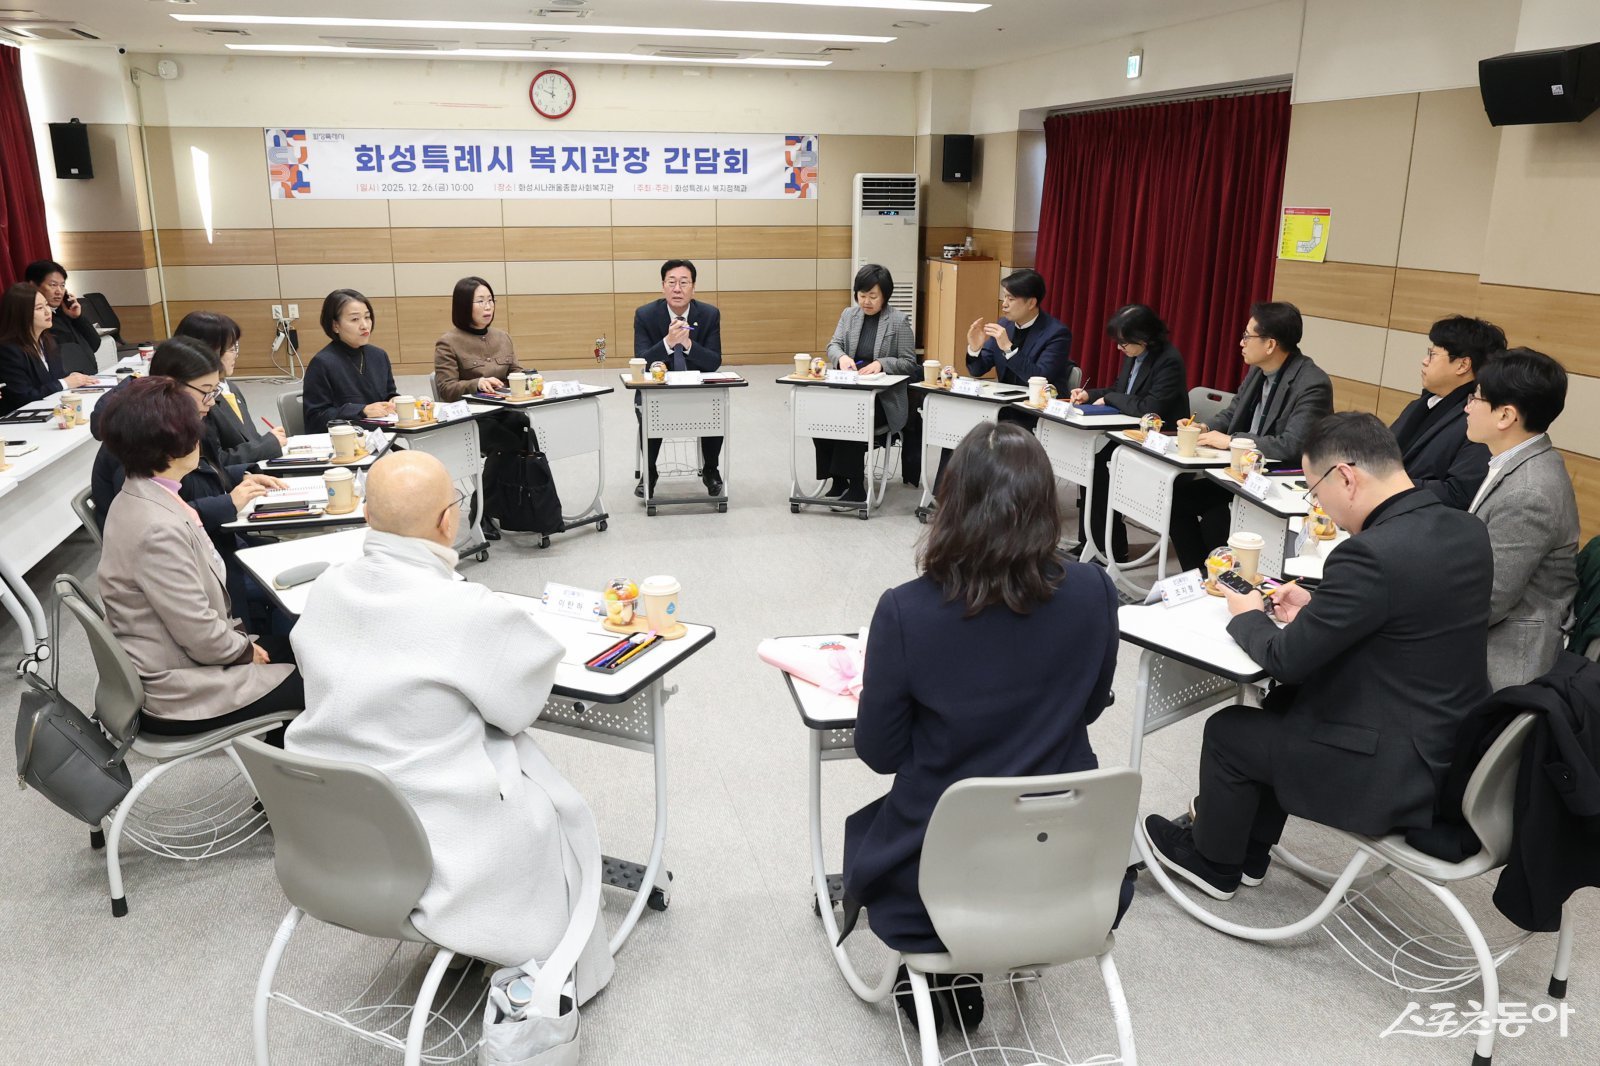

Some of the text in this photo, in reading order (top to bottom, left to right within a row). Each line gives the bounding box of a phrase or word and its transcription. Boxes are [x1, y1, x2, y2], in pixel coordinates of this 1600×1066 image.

[355, 145, 749, 174] 화성특례시 복지관장 간담회
[382, 183, 406, 192] 2025.
[408, 184, 420, 192] 12.
[451, 184, 474, 192] 10:00
[518, 183, 614, 192] 화성시나래울종합사회복지관
[675, 184, 710, 193] 화성특례시
[712, 184, 747, 193] 복지정책과
